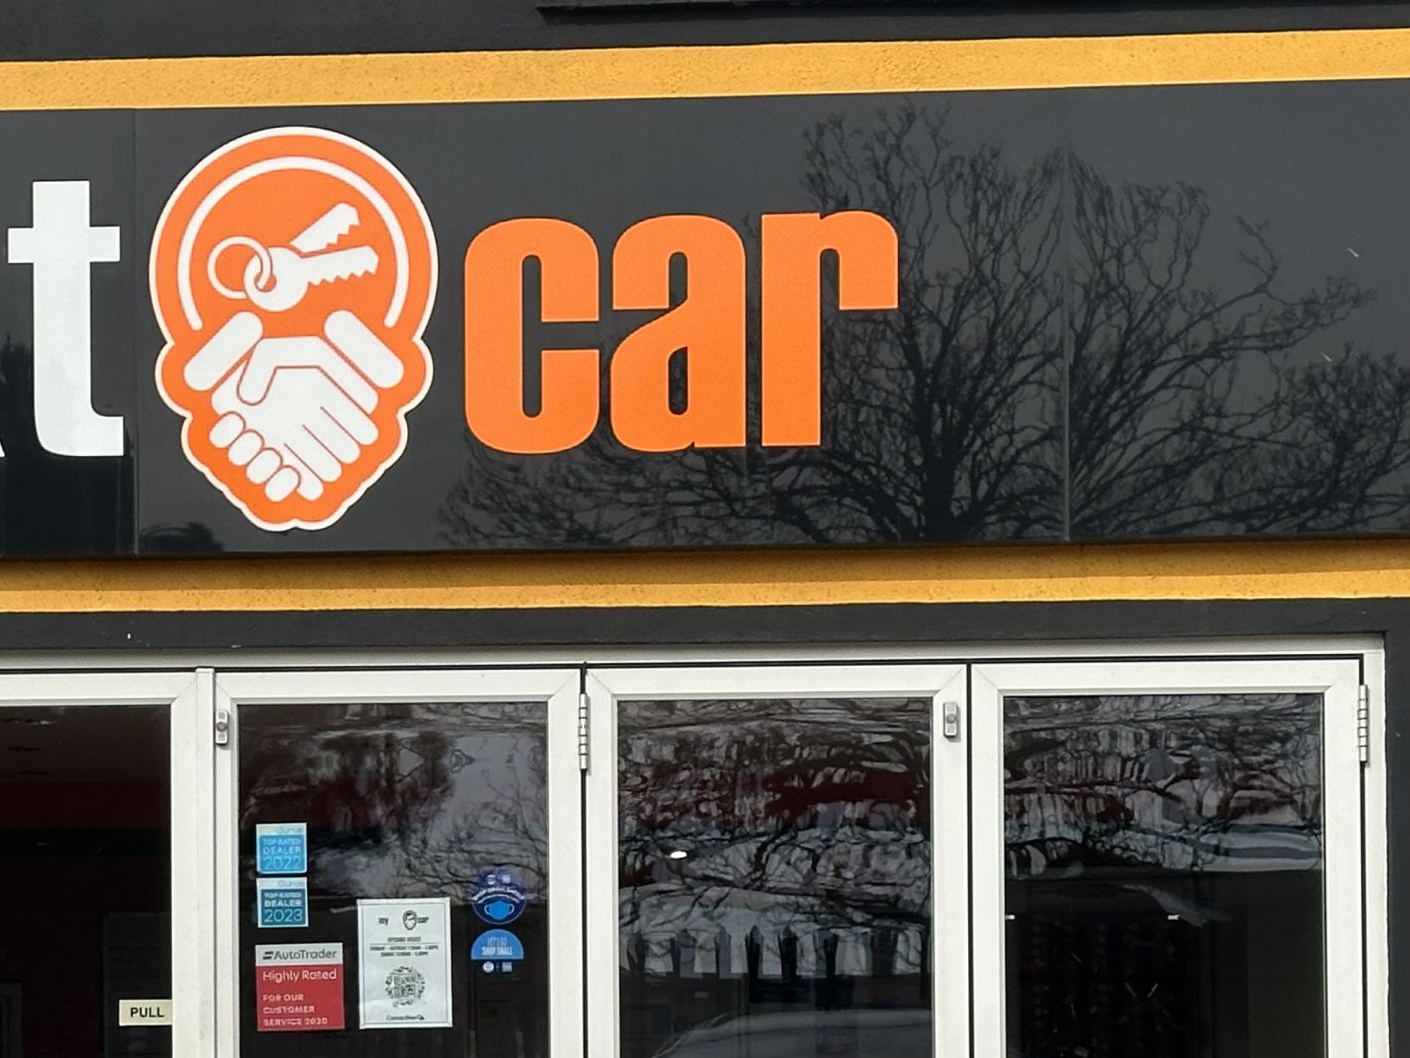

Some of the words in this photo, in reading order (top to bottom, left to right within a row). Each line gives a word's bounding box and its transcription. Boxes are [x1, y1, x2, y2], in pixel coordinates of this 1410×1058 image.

[463, 209, 900, 455] car
[262, 847, 302, 855] DEALER
[263, 856, 302, 870] 2022
[264, 899, 303, 907] DEALER
[264, 909, 303, 923] 2023
[273, 949, 338, 960] AutoTrader
[262, 970, 300, 983] Highly
[302, 968, 337, 980] Rated
[130, 1006, 165, 1018] PULL
